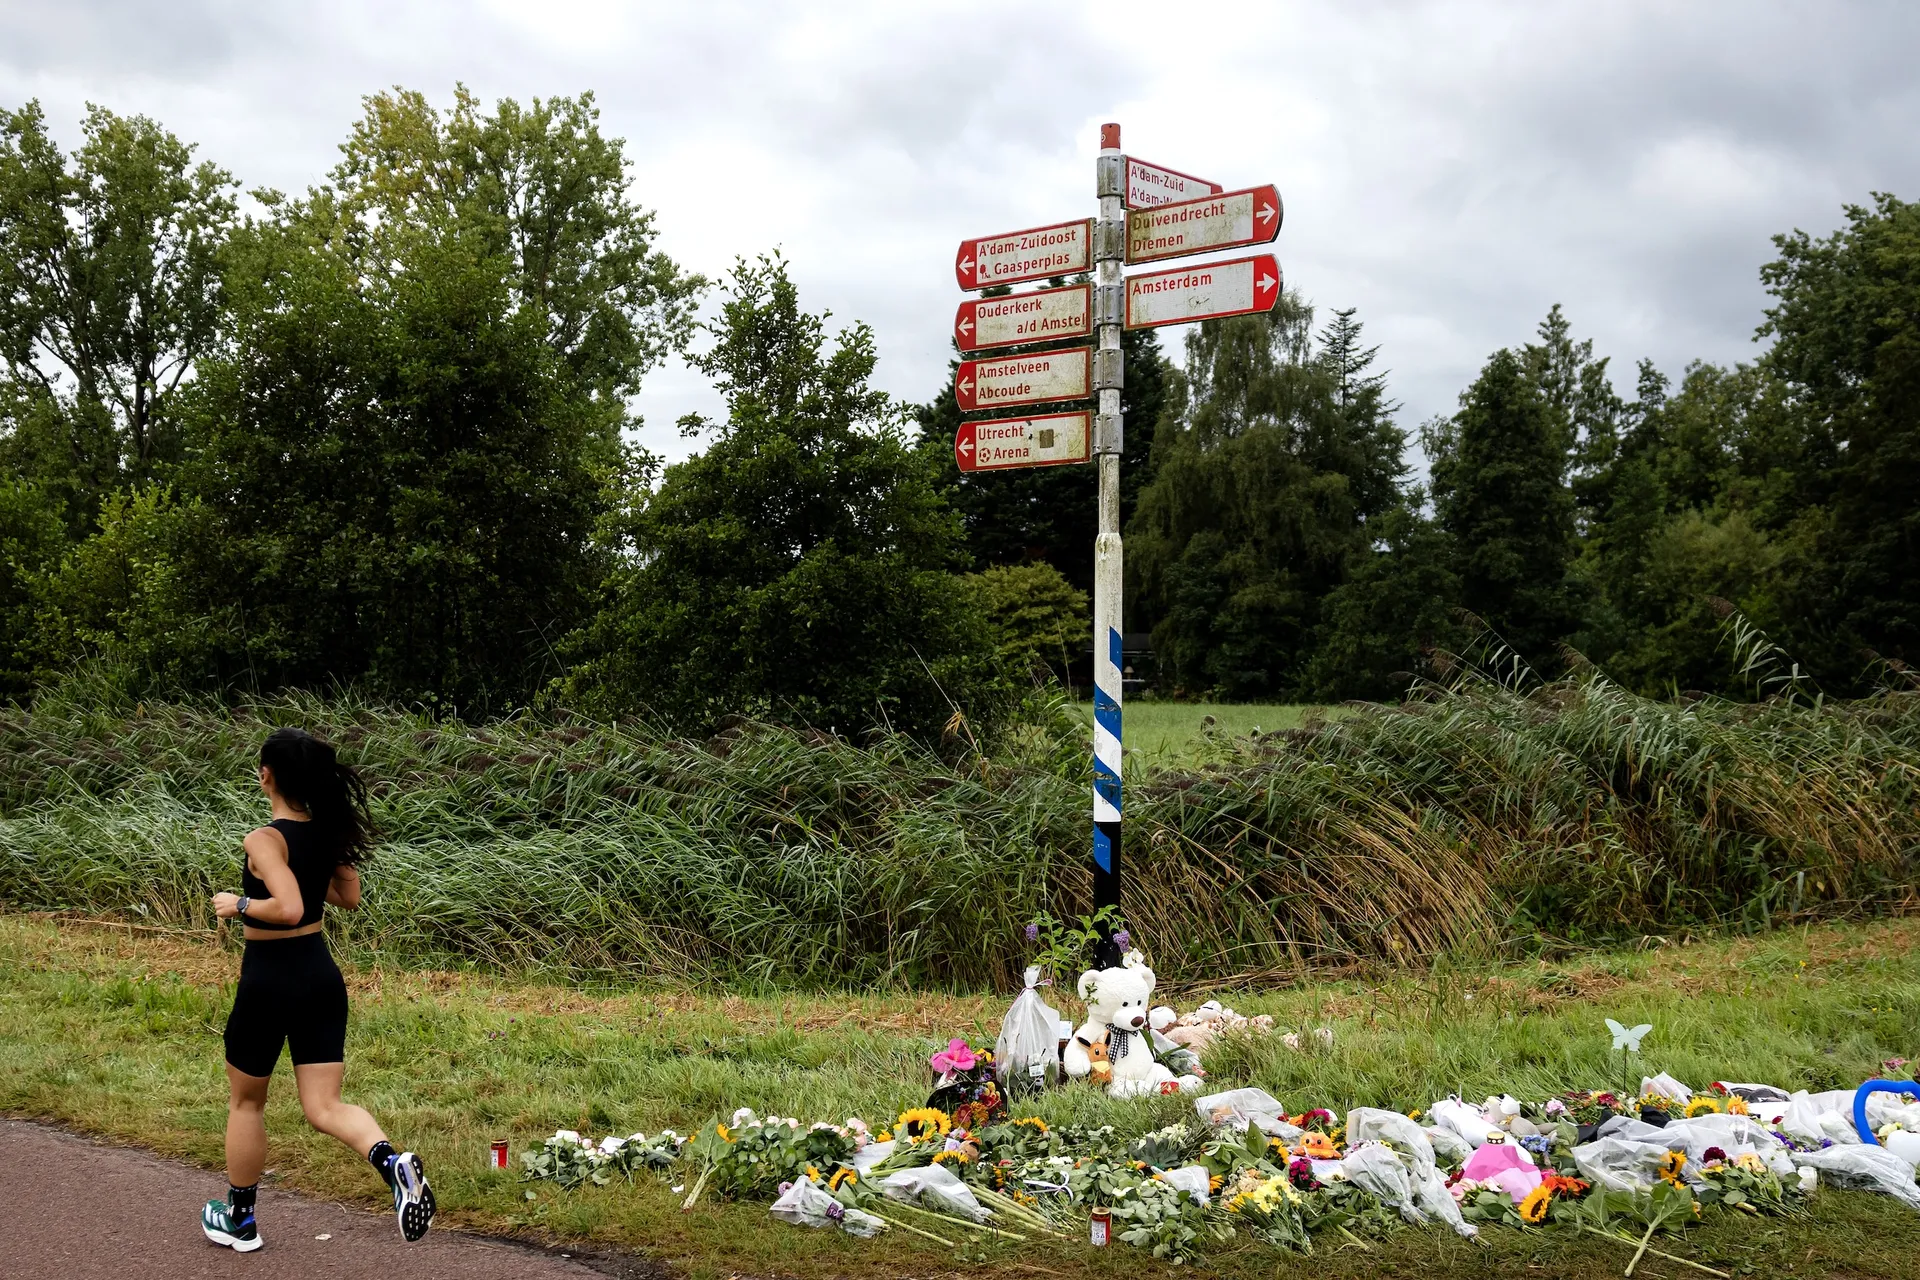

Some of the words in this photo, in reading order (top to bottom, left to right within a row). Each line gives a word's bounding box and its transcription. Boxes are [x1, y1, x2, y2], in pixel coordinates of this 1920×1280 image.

[1131, 165, 1184, 192] A'dam-Zuid
[1133, 203, 1226, 230] Duivendrecht
[979, 229, 1076, 257] A'dam-Zuidoost
[1133, 234, 1183, 252] Diemen
[994, 253, 1070, 275] Gaasperplas
[1132, 273, 1212, 296] Amsterdam
[978, 298, 1043, 319] Ouderkerk
[1017, 319, 1037, 334] a/d
[1040, 312, 1086, 331] Amstel
[978, 361, 1050, 379] Amstelveen
[978, 383, 1031, 399] Abcoude
[978, 425, 1024, 440] Utrecht
[993, 447, 1029, 460] Arena
